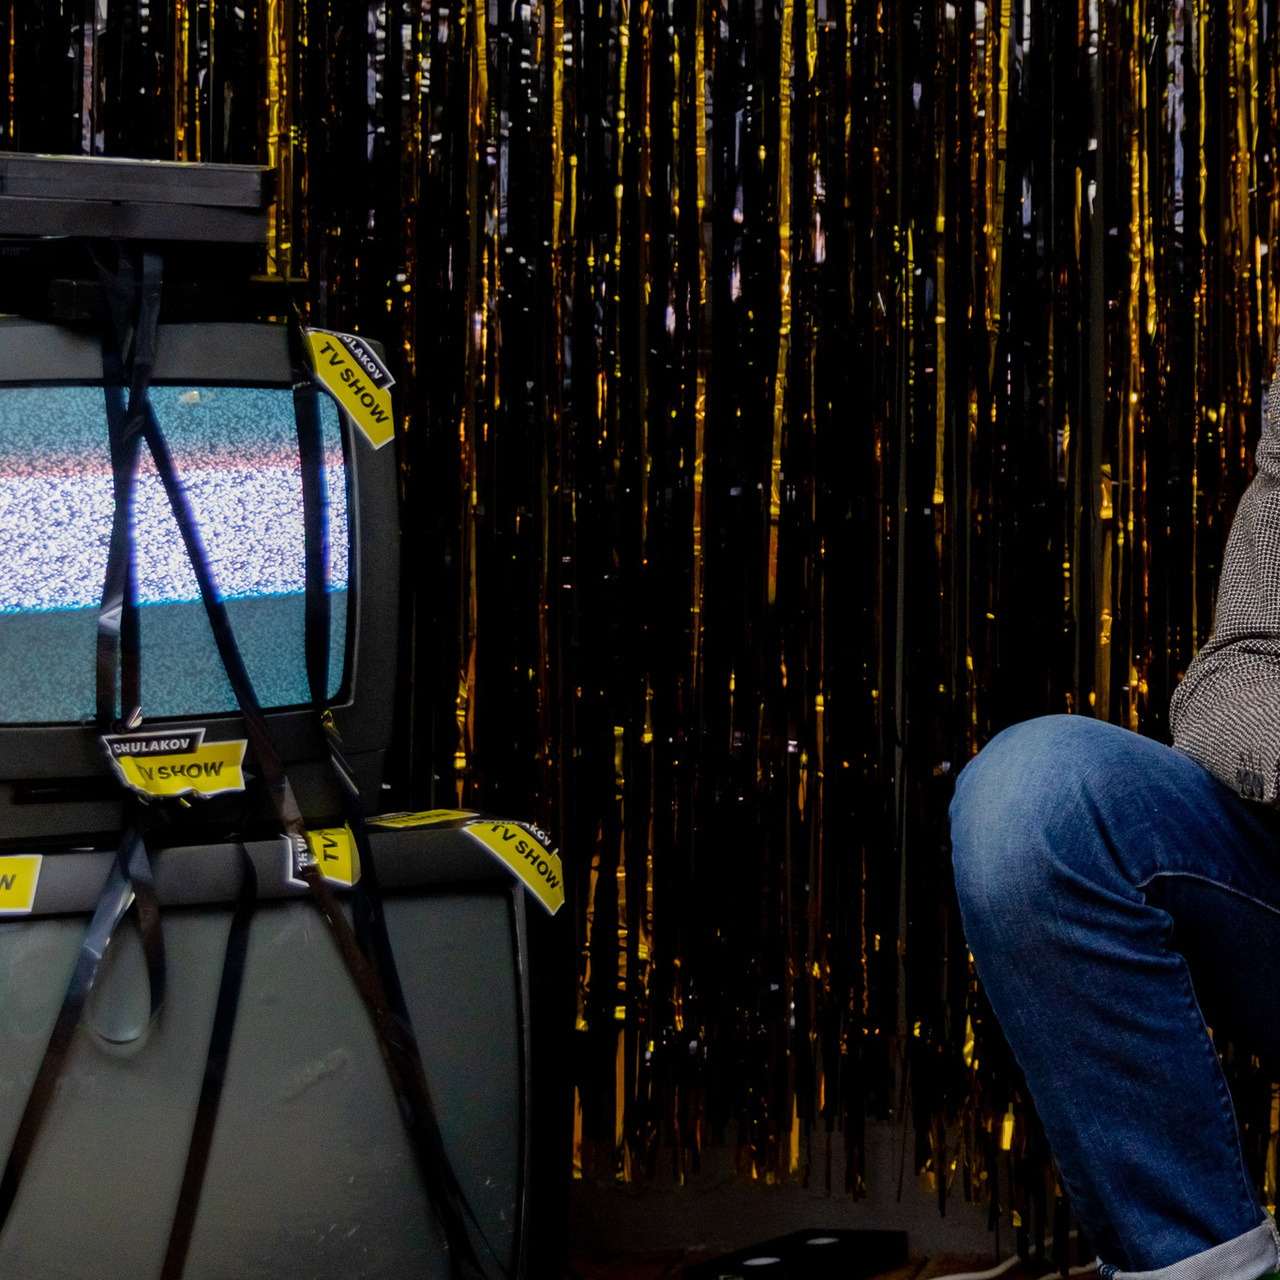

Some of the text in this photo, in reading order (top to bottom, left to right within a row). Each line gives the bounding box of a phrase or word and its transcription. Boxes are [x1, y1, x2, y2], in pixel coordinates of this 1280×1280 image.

[342, 336, 384, 380] ULAKOV
[320, 341, 390, 424] TV SHOW
[113, 738, 191, 754] CHULAKOV
[158, 761, 224, 780] SHOW
[323, 836, 339, 862] TV
[492, 825, 560, 889] TV SHOW
